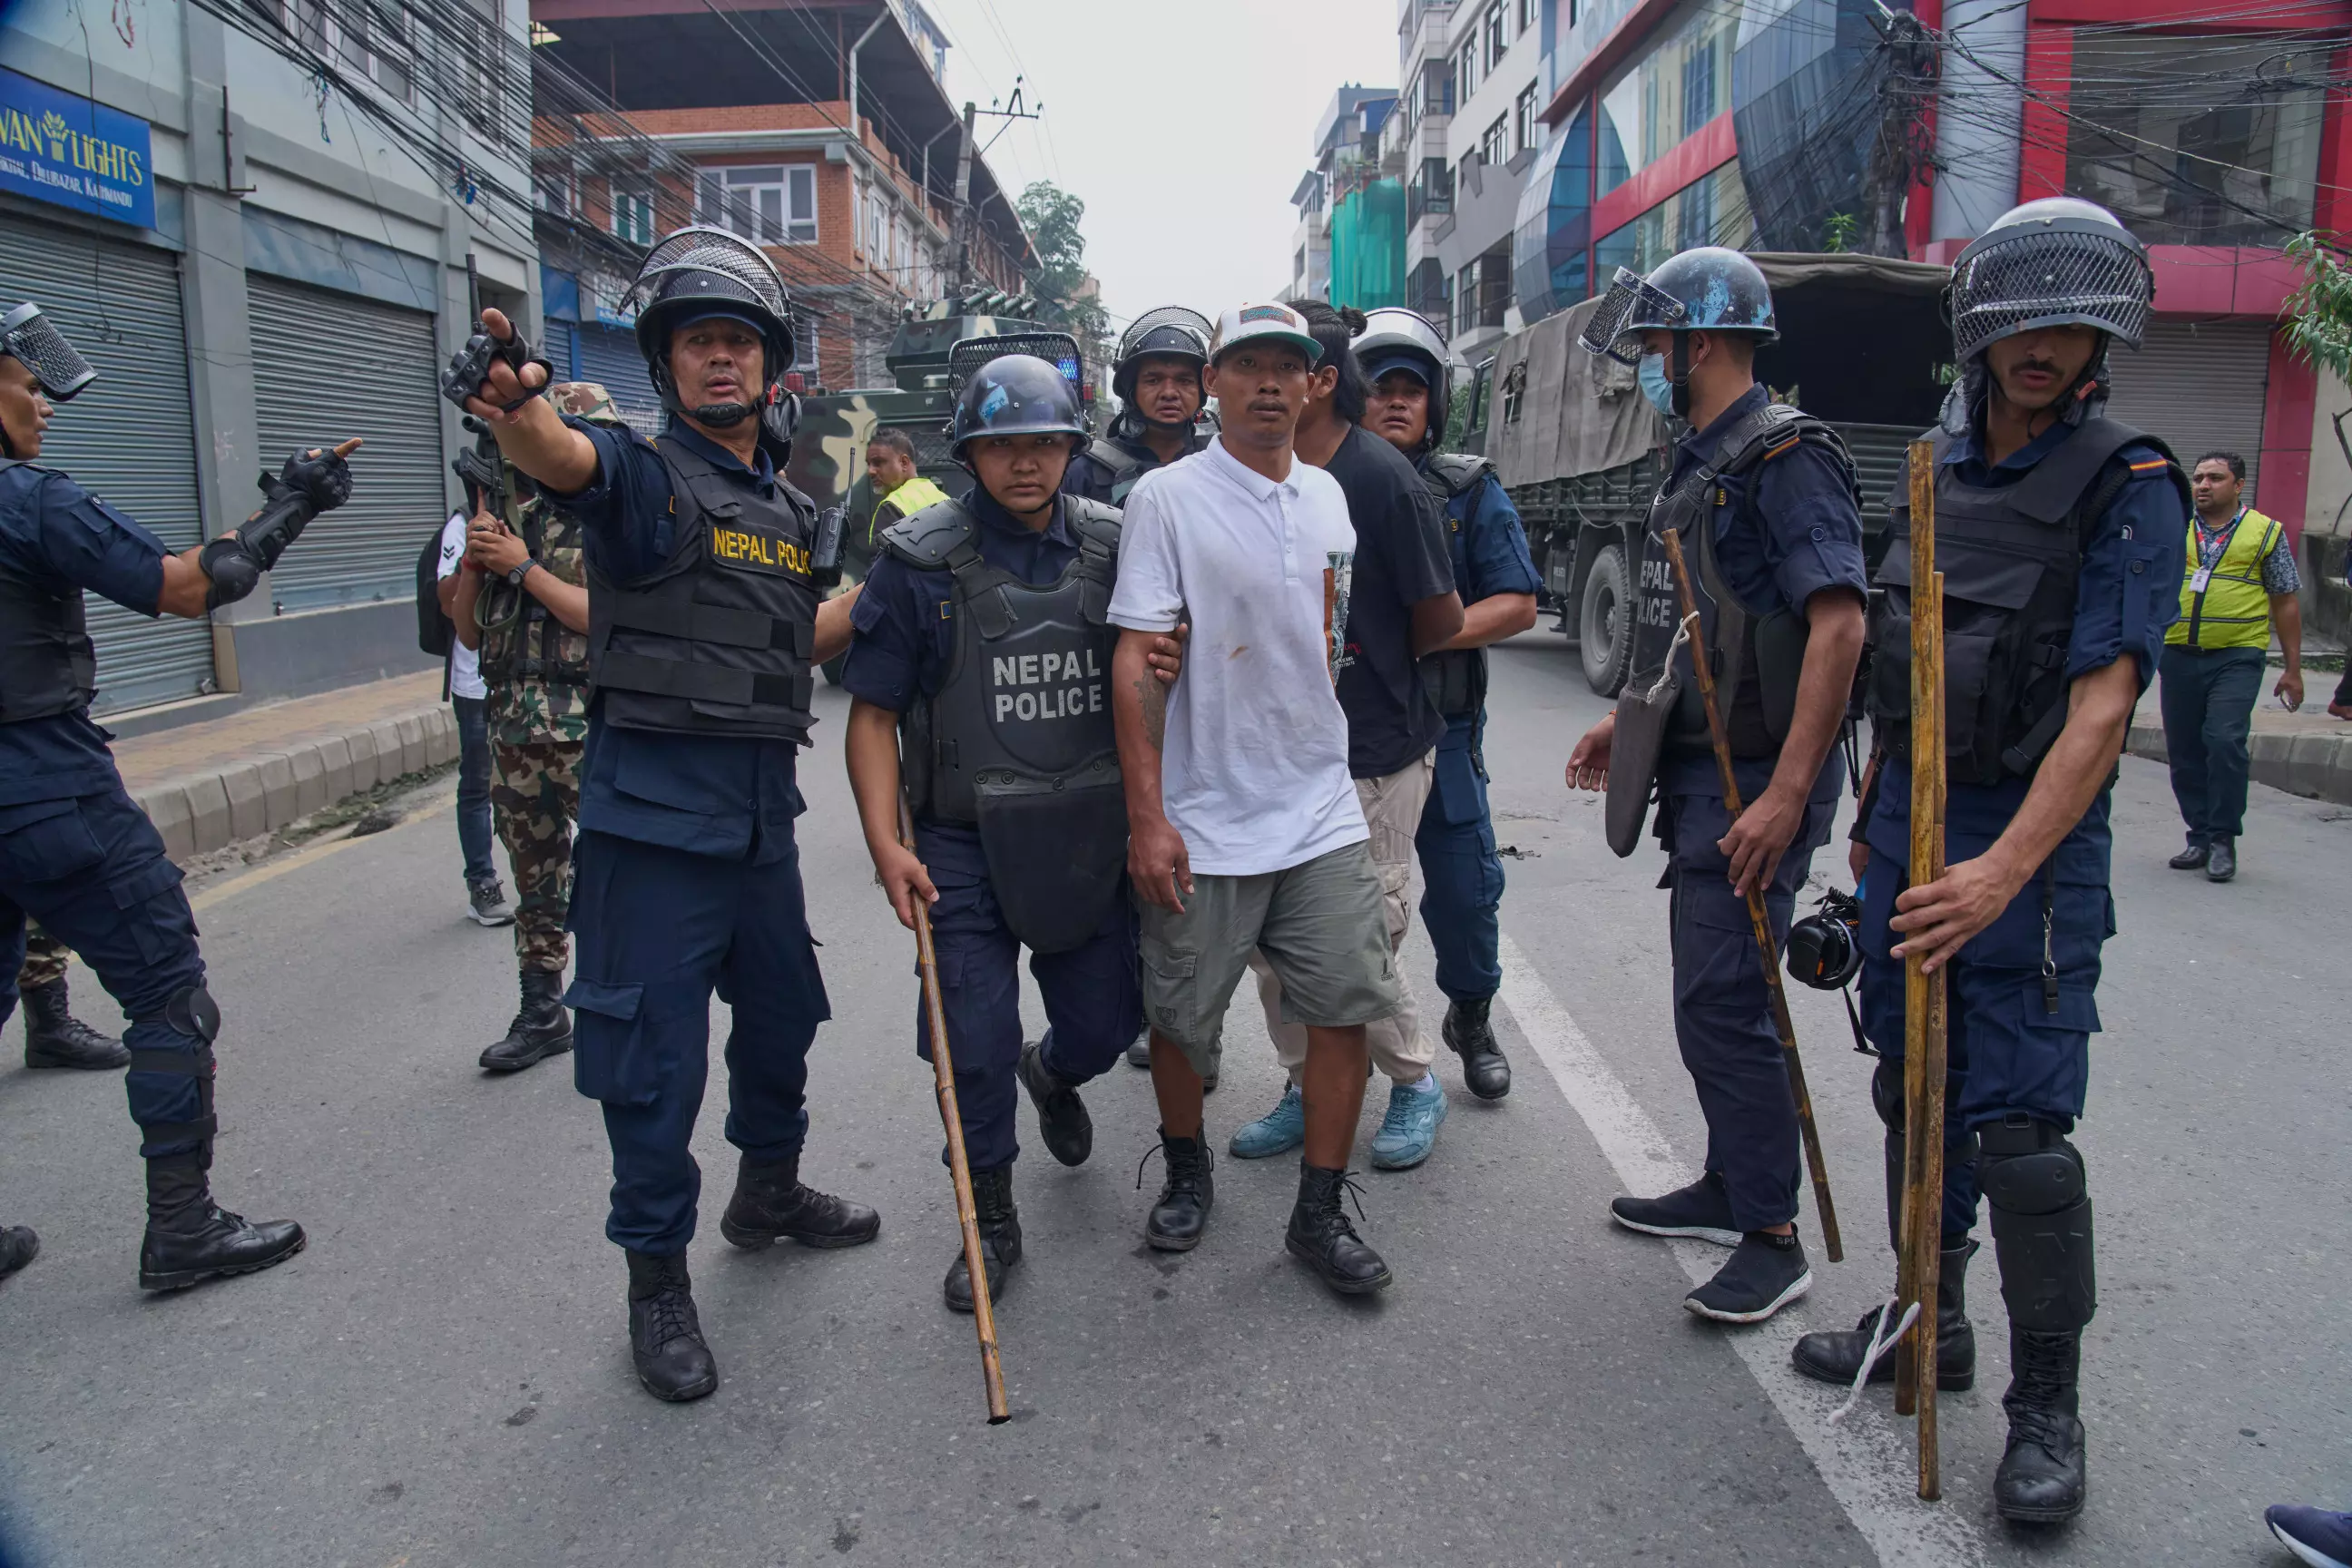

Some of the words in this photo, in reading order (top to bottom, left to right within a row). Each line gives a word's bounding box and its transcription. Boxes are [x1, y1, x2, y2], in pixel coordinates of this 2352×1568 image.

[71, 130, 142, 186] LIGHTS
[713, 527, 774, 565] NEPAL
[993, 649, 1101, 686] NEPAL
[995, 683, 1102, 722] POLICE
